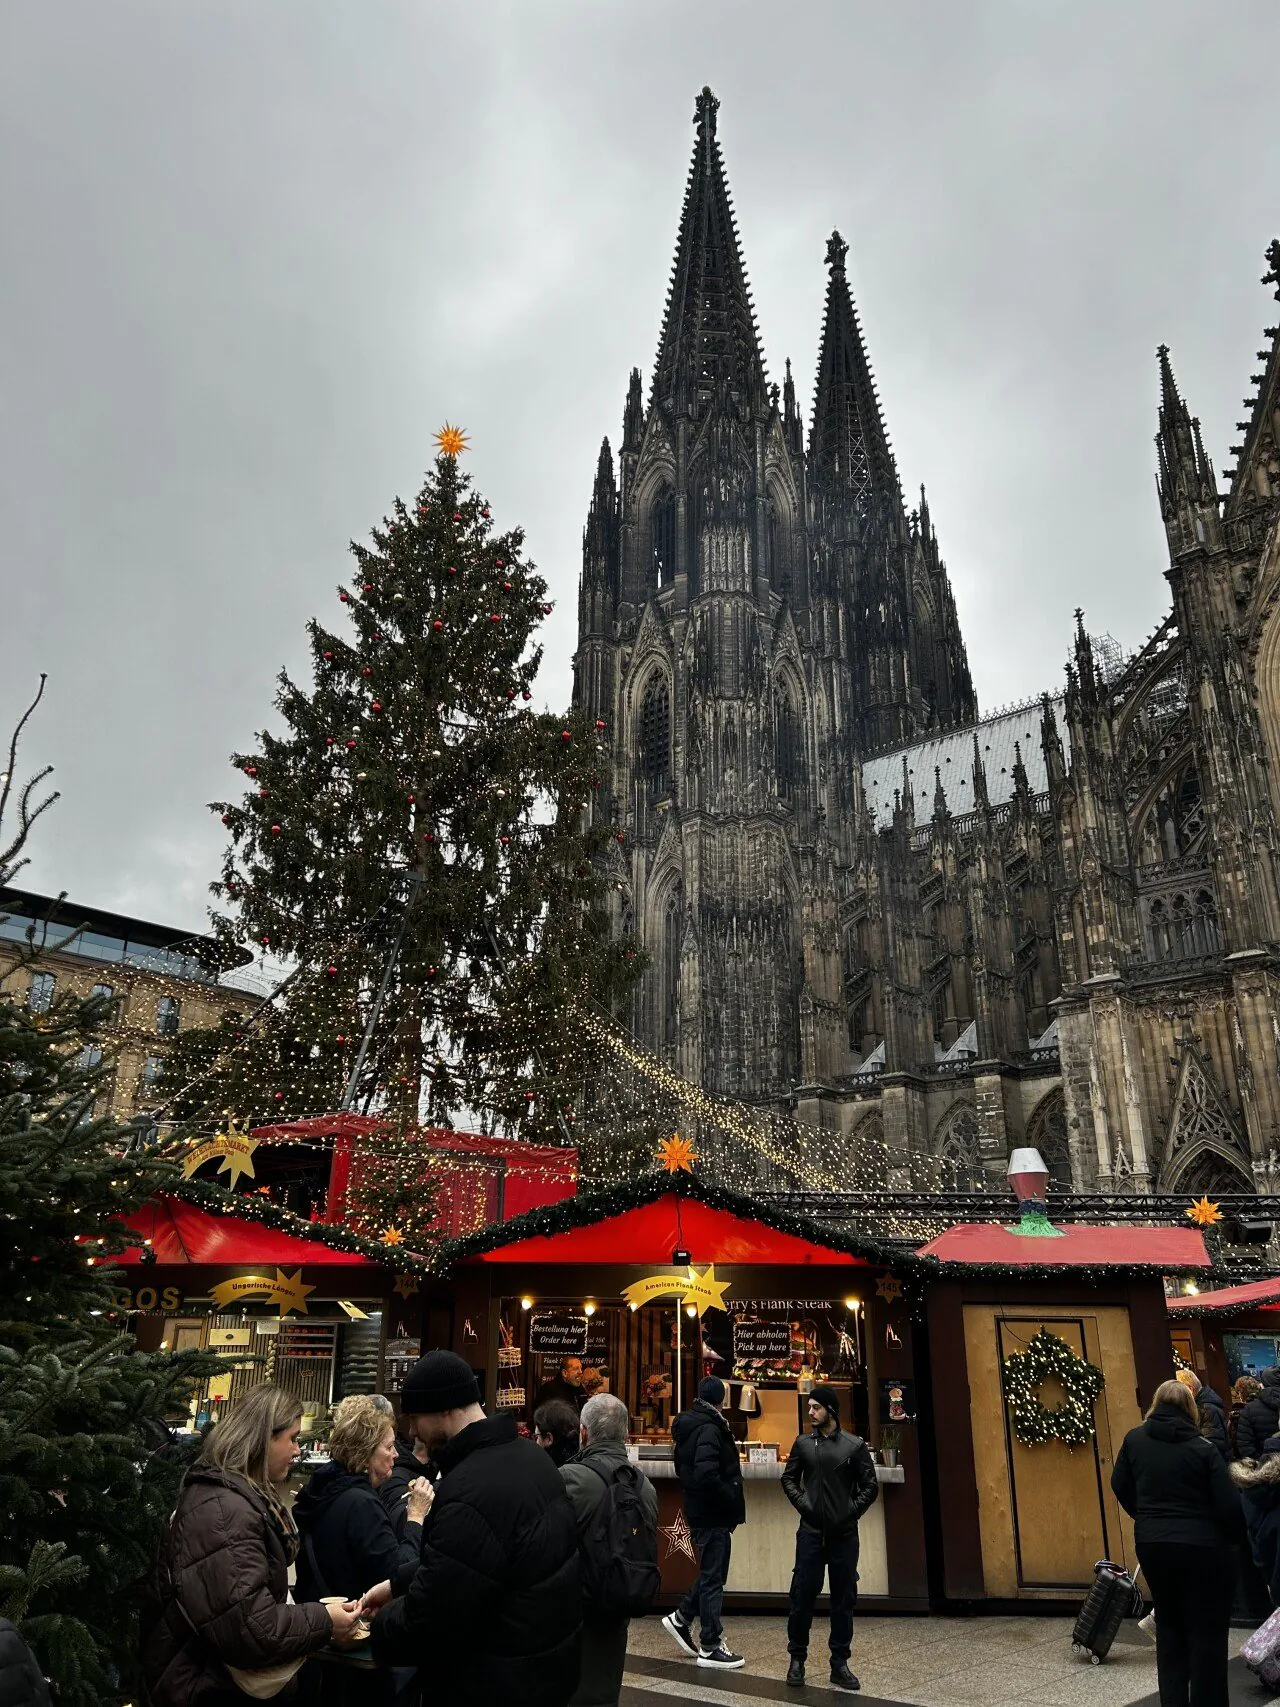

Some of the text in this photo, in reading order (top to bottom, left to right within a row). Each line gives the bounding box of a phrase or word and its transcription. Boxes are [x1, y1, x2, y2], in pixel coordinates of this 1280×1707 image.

[232, 1282, 271, 1290] Ungarische
[645, 1281, 712, 1296] American Flank Steak
[534, 1325, 585, 1335] Bestellung hier
[737, 1329, 788, 1339] Hier abholen
[540, 1335, 578, 1345] Order here
[737, 1342, 787, 1353] Pick up here
